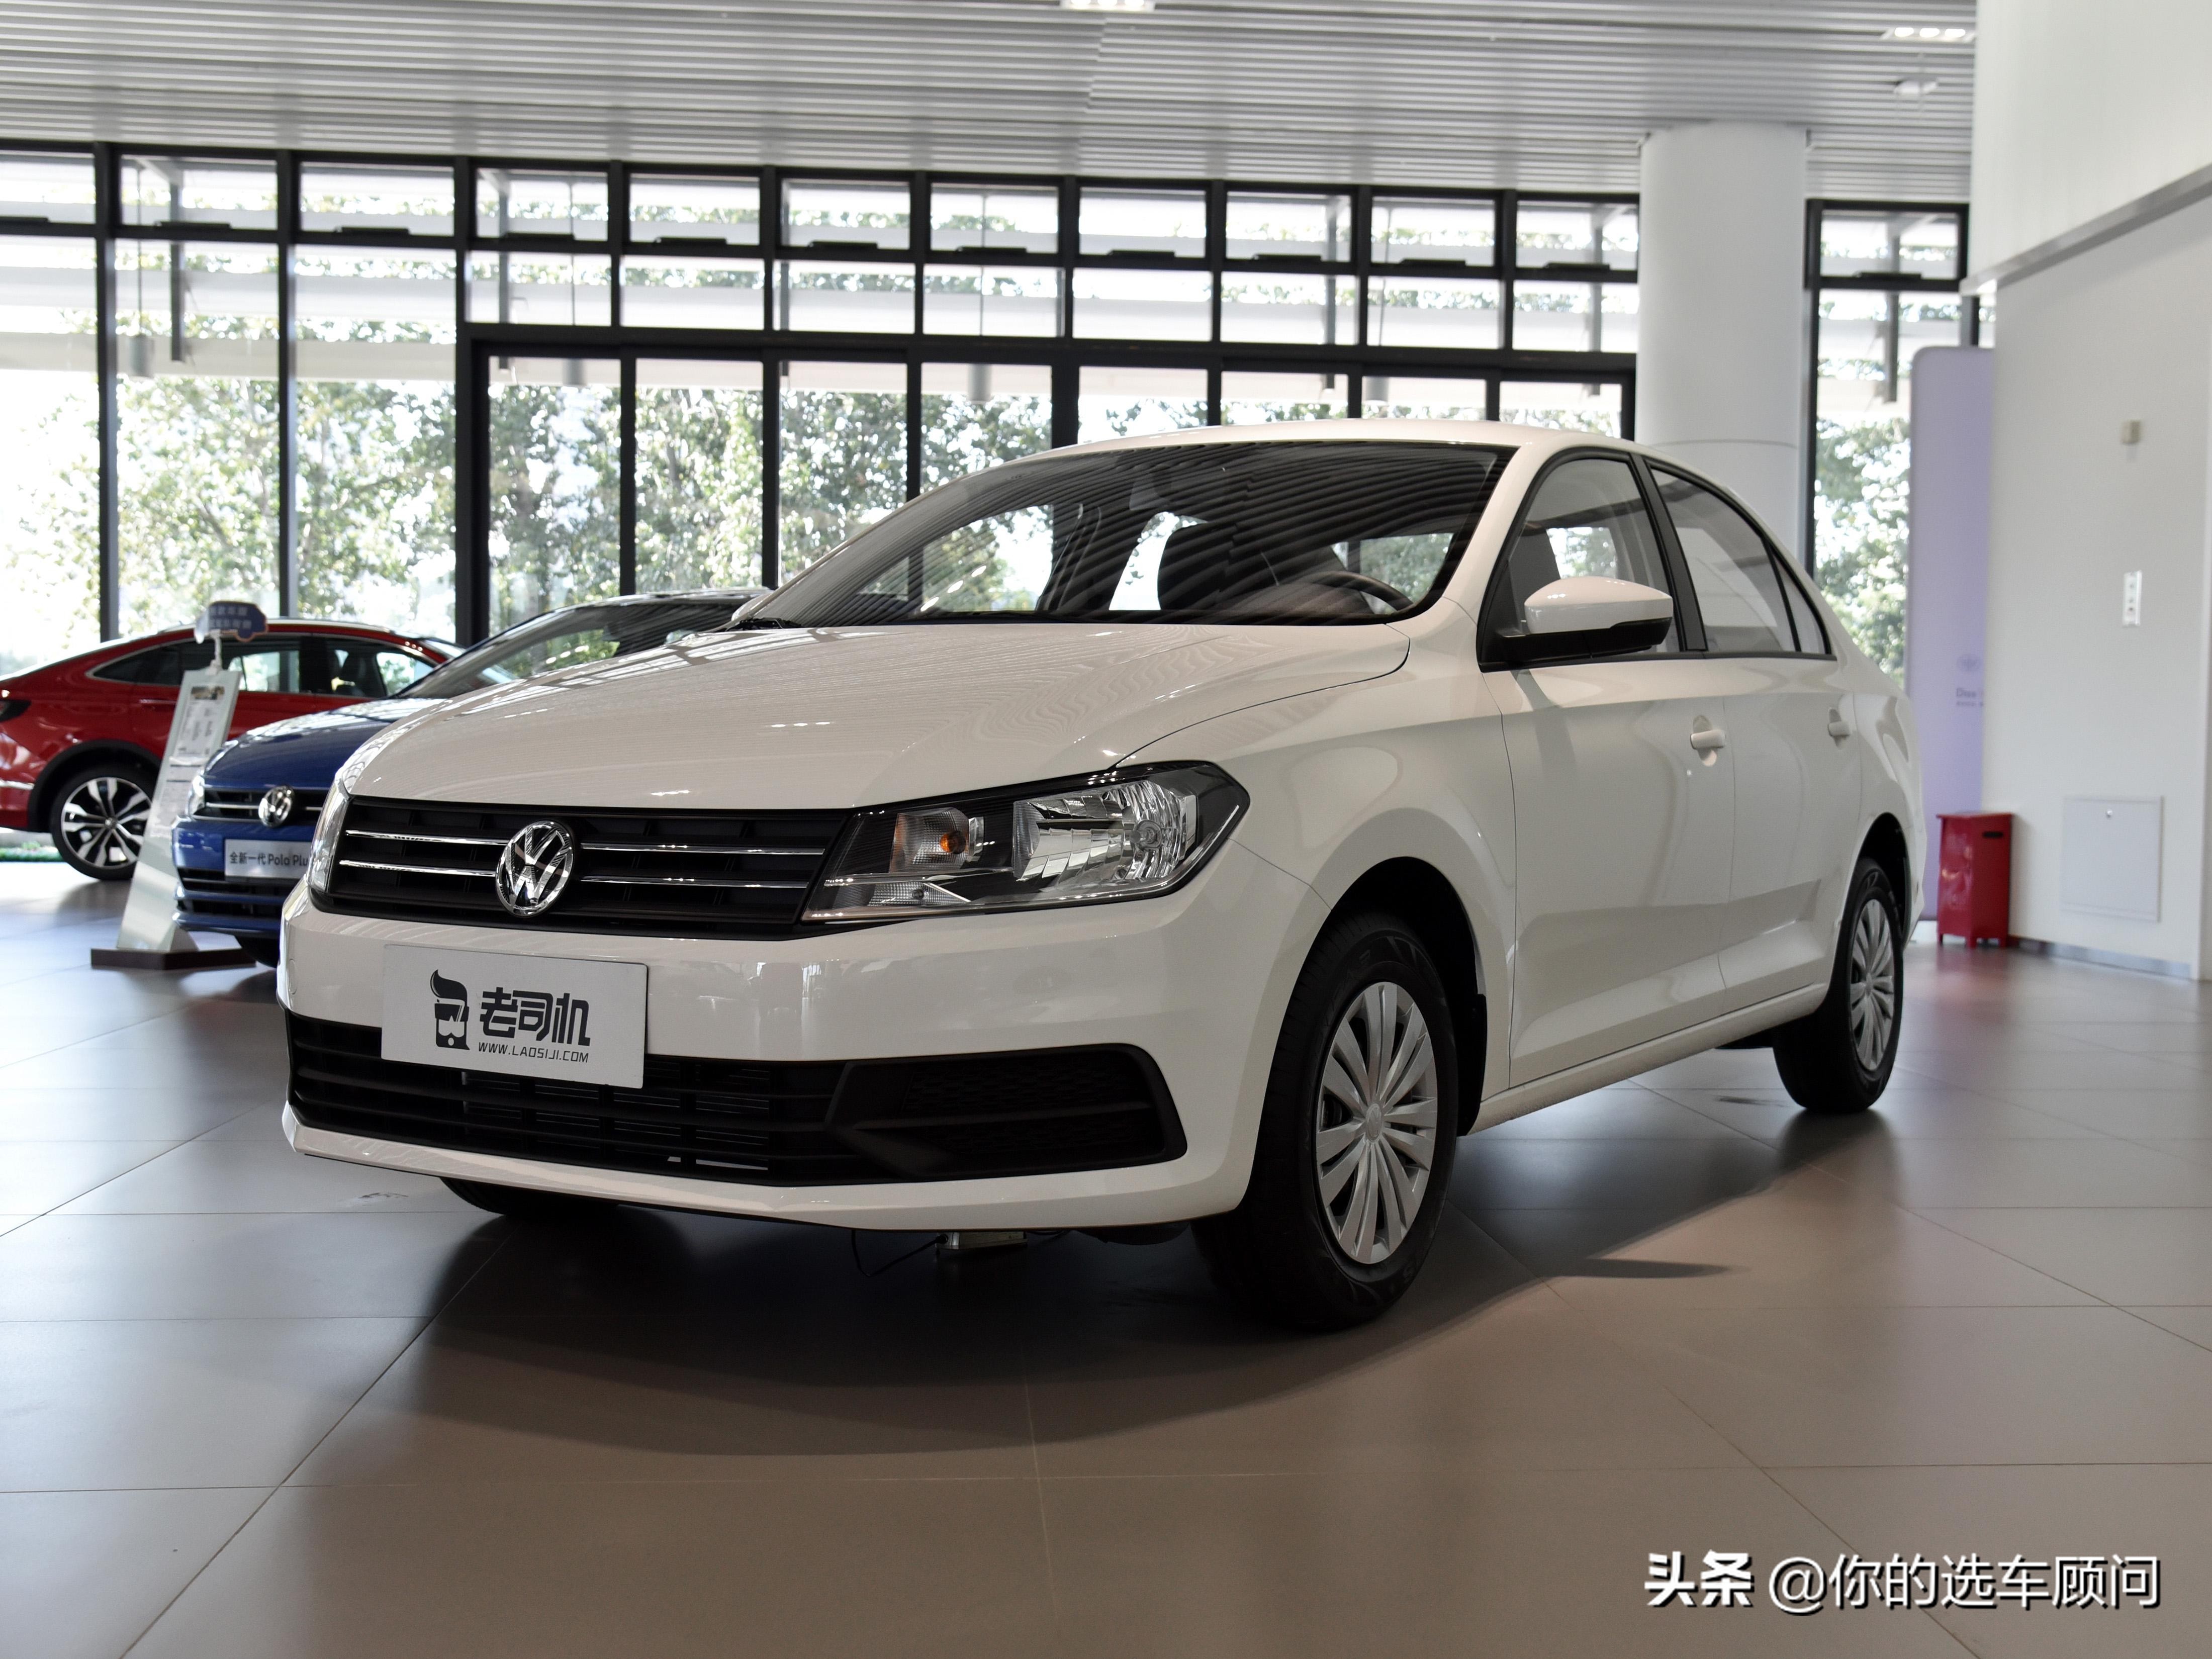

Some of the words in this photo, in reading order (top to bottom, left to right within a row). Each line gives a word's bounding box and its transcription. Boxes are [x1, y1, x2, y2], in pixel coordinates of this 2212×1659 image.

[230, 852, 266, 865] 全新一代
[268, 853, 290, 866] Polo
[293, 855, 309, 866] Plu
[479, 986, 591, 1047] 老司机
[478, 1042, 589, 1063] WWW.LAOSIJI.COM
